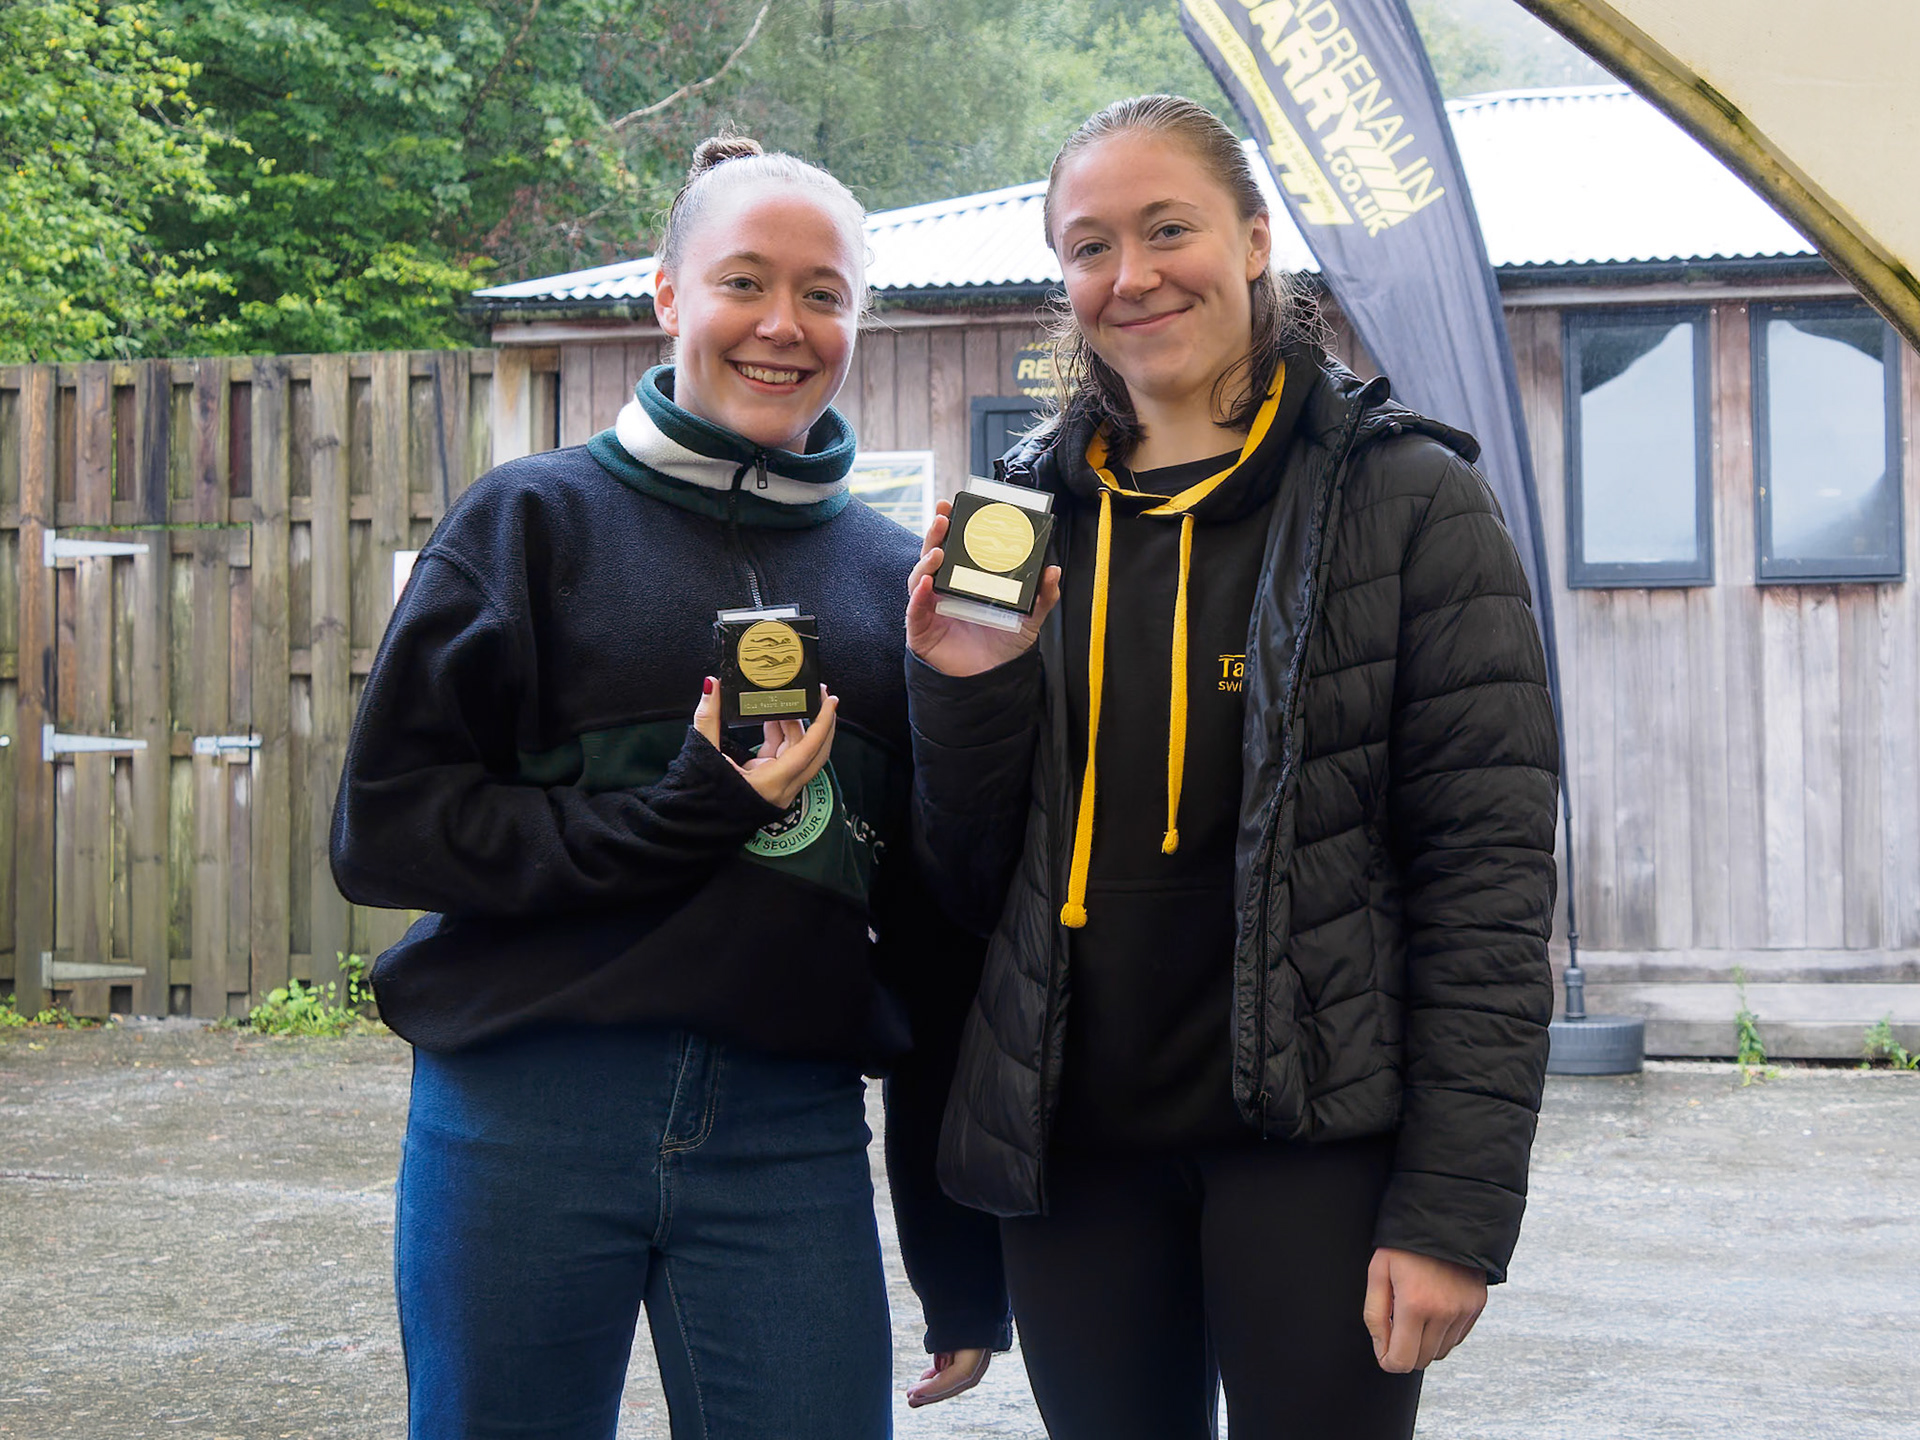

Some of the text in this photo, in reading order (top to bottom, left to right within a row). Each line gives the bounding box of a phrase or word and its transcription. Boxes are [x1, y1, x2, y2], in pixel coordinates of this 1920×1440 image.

[1198, 0, 1233, 43] OWING
[1238, 0, 1380, 151] ARRY
[762, 815, 822, 850] SEQUIMUR
